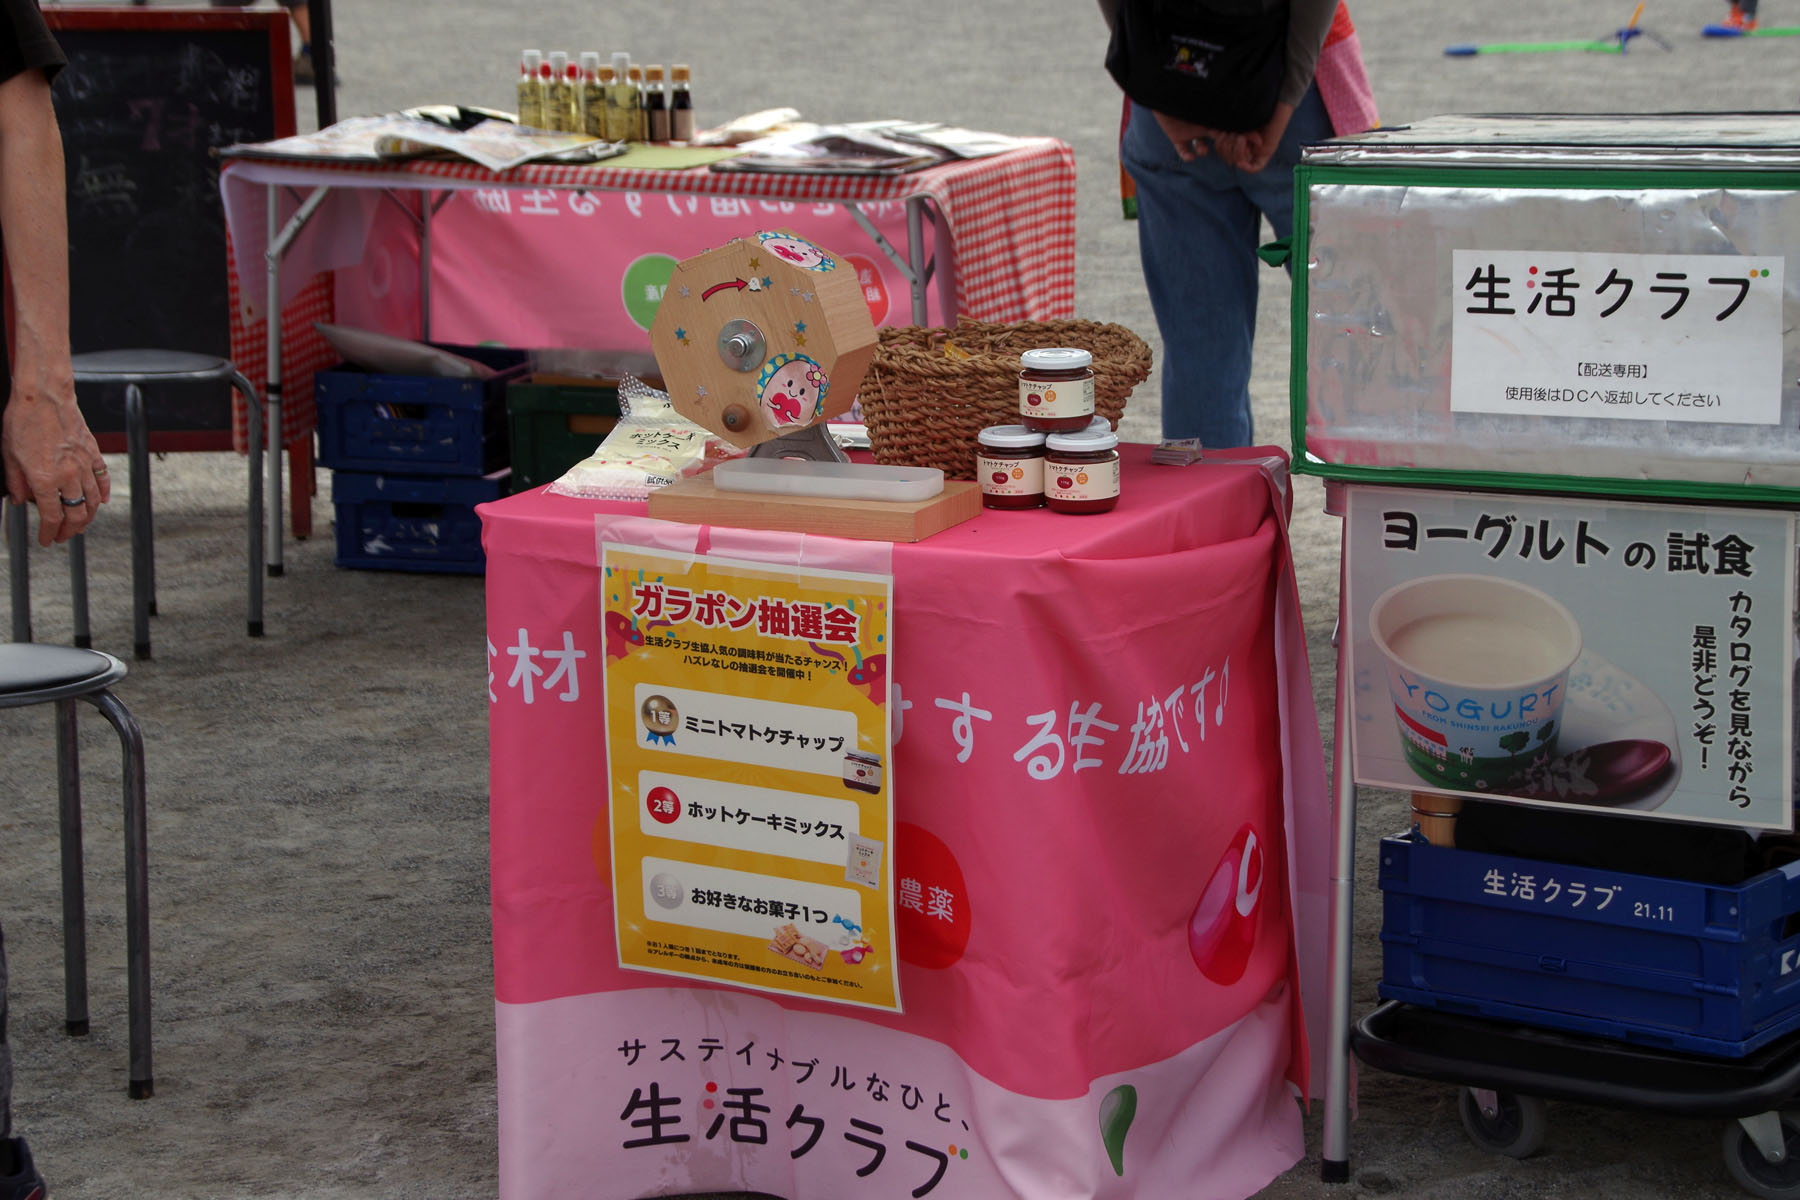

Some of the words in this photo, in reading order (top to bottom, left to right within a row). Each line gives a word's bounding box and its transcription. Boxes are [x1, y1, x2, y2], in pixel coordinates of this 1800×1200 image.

[634, 583, 858, 642] ガラポン抽選会
[1400, 674, 1559, 720] YOGURT
[1727, 590, 1754, 809] カタログを見ながら
[685, 715, 845, 752] ミニトマトケチャップ
[1422, 710, 1448, 725] FROM
[1450, 720, 1490, 732] SHINSEI
[687, 801, 845, 840] ホットケーキミックス
[691, 887, 829, 924] お好きなお菓子1つ
[899, 876, 955, 923] 農薬
[1483, 868, 1622, 912] 生活クラブ
[1633, 902, 1674, 921] 21.11
